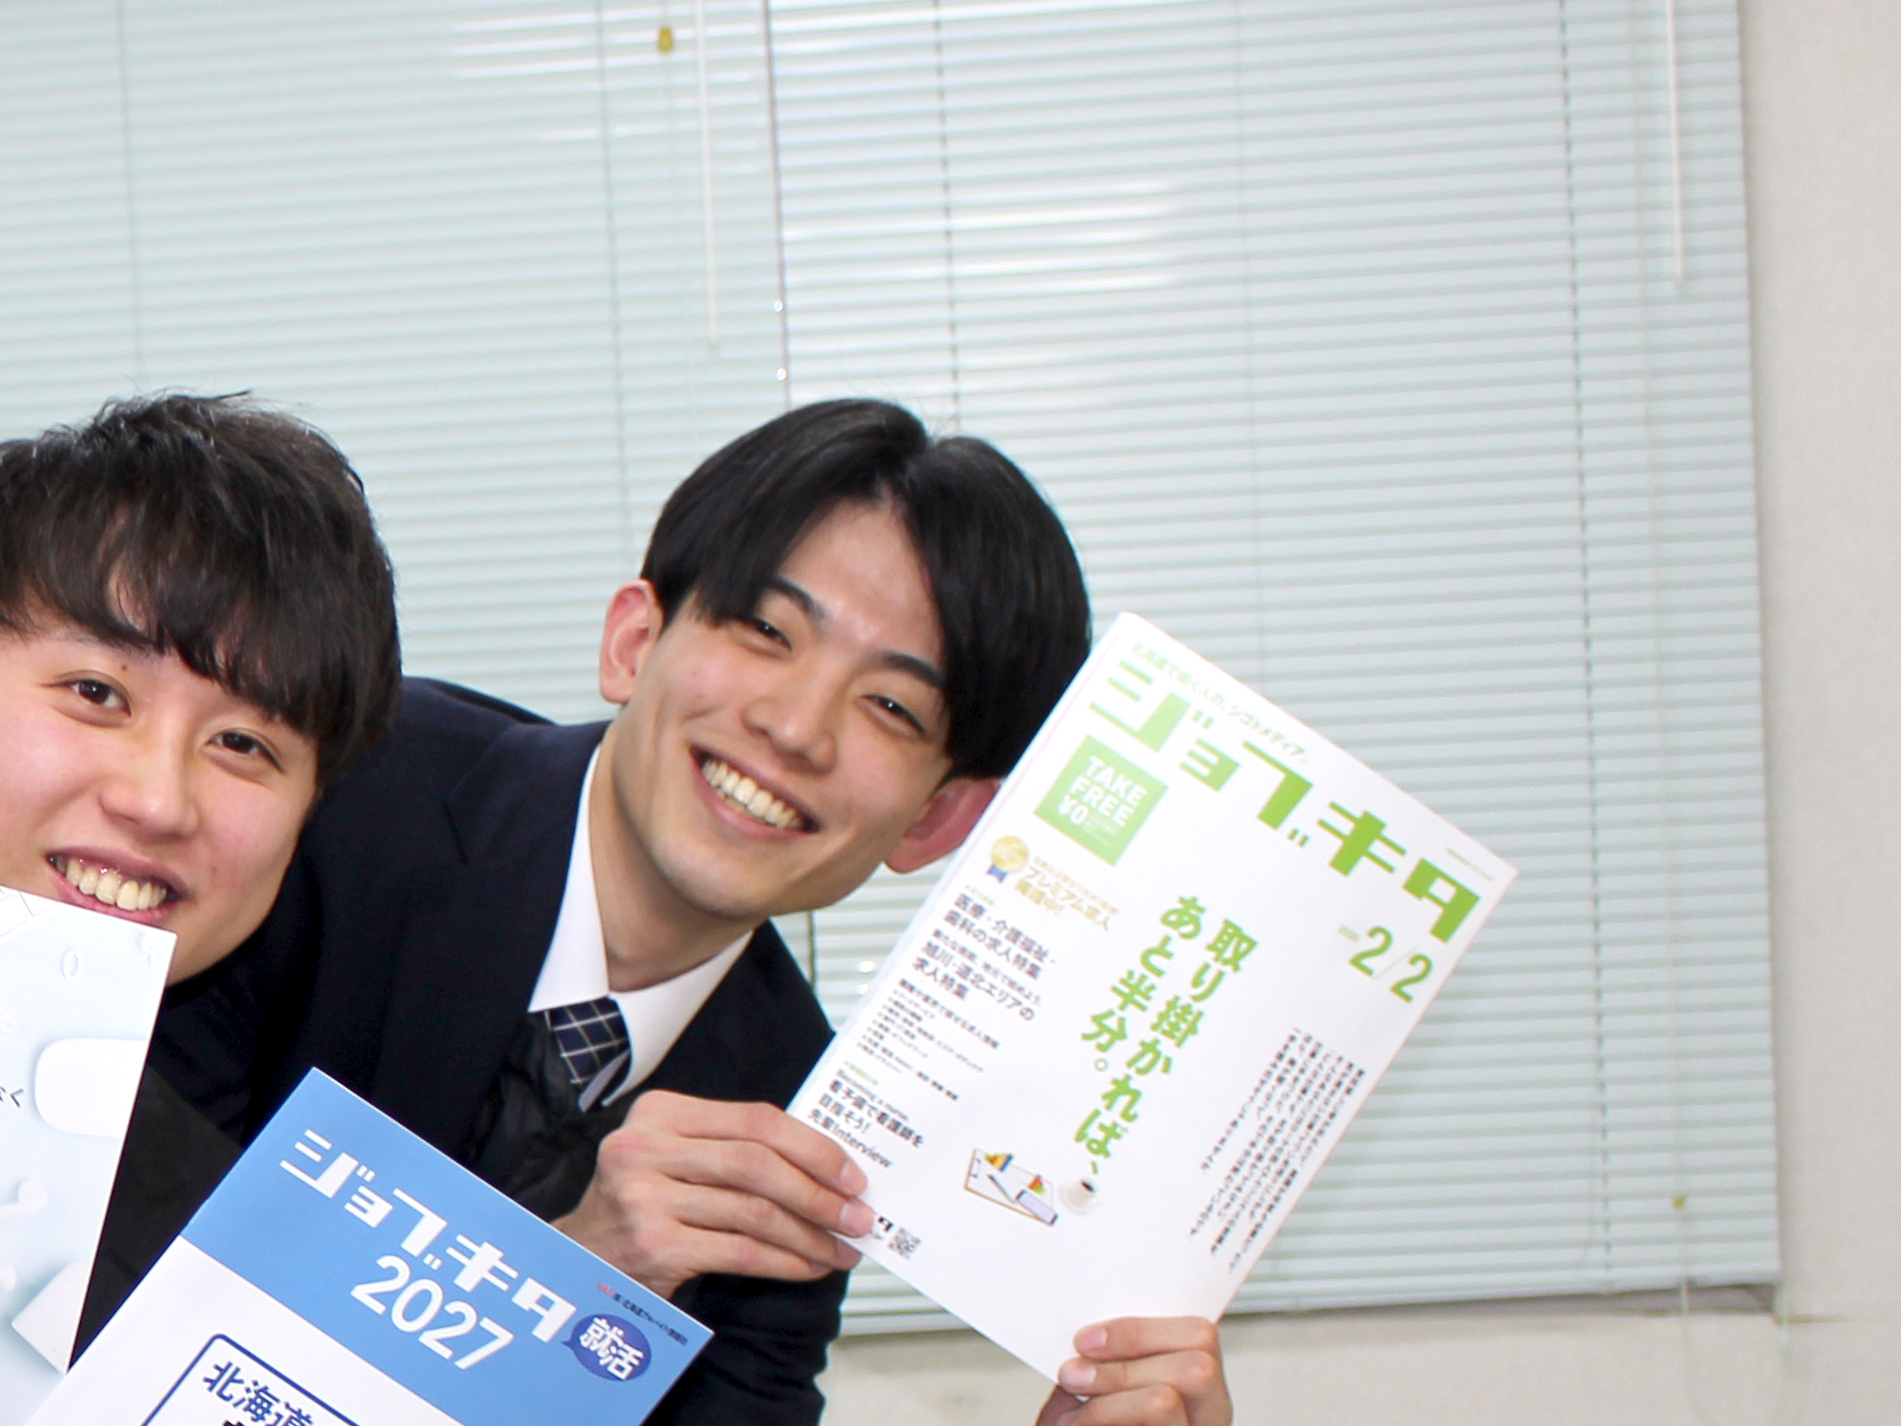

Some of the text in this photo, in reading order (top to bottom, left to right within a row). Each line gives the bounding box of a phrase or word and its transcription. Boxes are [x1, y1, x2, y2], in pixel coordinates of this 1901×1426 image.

[1069, 774, 1134, 827] FREE
[1086, 756, 1147, 804] TAKE
[1089, 659, 1481, 944] ジョブキタ
[1074, 918, 1258, 1175] 取り掛かれば、
[1080, 896, 1206, 1072] あと半分。
[280, 1129, 577, 1343] ジョブキタ
[350, 1254, 515, 1370] 2027
[578, 1316, 644, 1381] 就活
